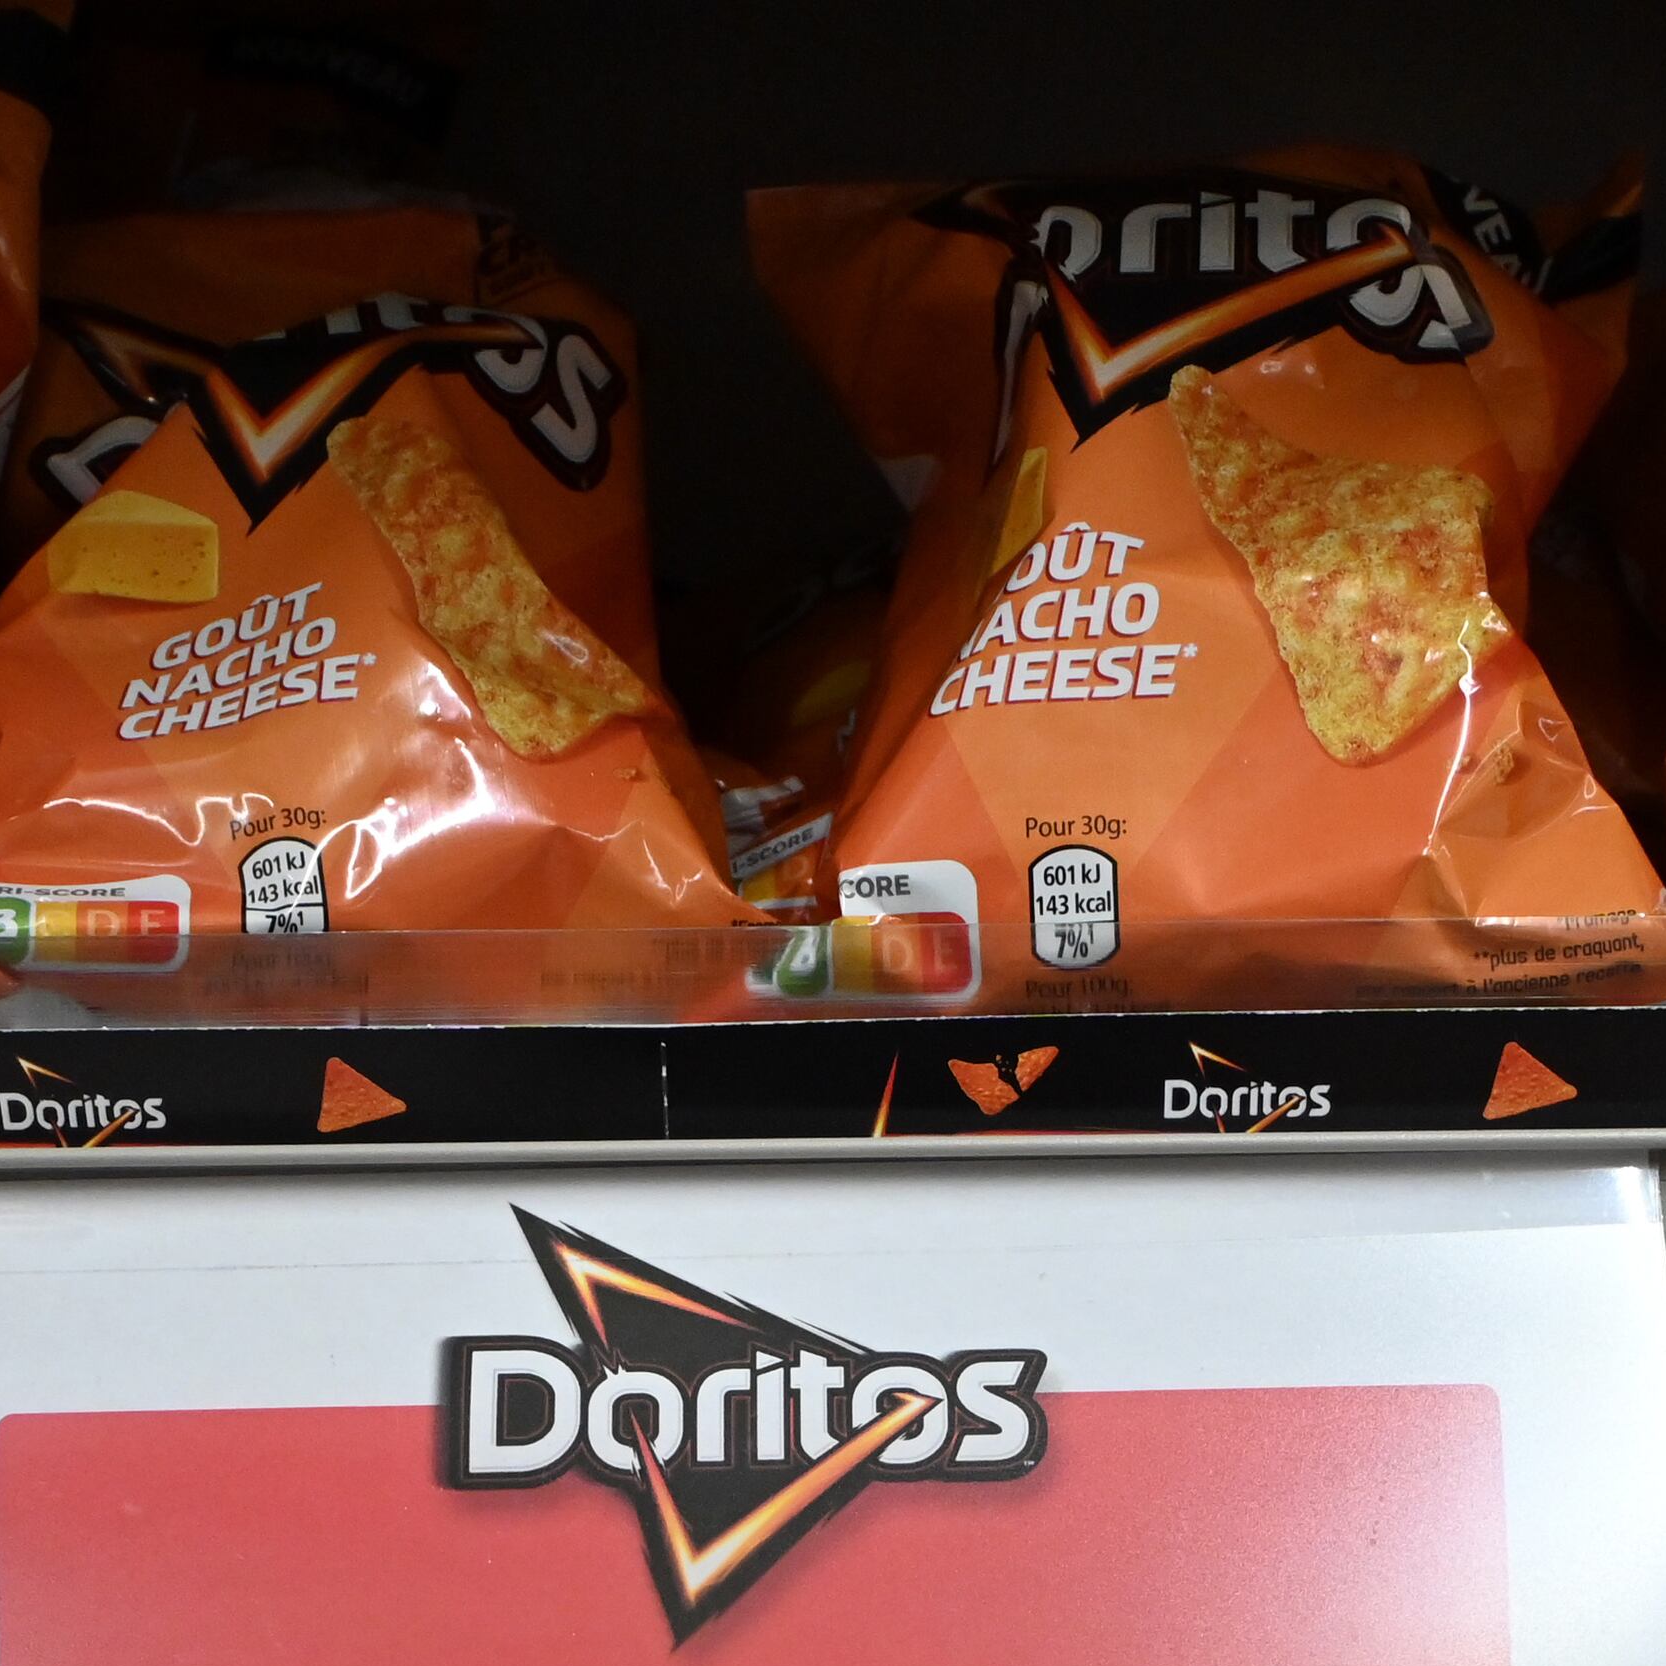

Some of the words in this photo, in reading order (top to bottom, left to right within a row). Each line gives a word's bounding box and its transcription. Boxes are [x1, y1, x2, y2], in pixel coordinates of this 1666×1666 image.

[1005, 521, 1146, 594] OÛT
[152, 581, 323, 672] GOÛT
[120, 616, 336, 710] NACHO
[229, 816, 277, 843] Pour
[280, 806, 327, 831] 30g:
[1024, 817, 1077, 839] Pour
[1080, 814, 1128, 838] 30g:
[250, 856, 282, 881] 601
[284, 852, 307, 877] kJ
[1042, 865, 1077, 887] 601
[1080, 864, 1101, 886] kJ
[247, 882, 279, 907] 143
[282, 873, 321, 899] kcal
[1034, 894, 1071, 916] 143
[1073, 890, 1113, 914] kcal
[1533, 945, 1558, 962] de
[1562, 932, 1646, 962] craquant,
[1163, 1077, 1332, 1120] Doritos
[468, 1346, 1040, 1476] Doritos
